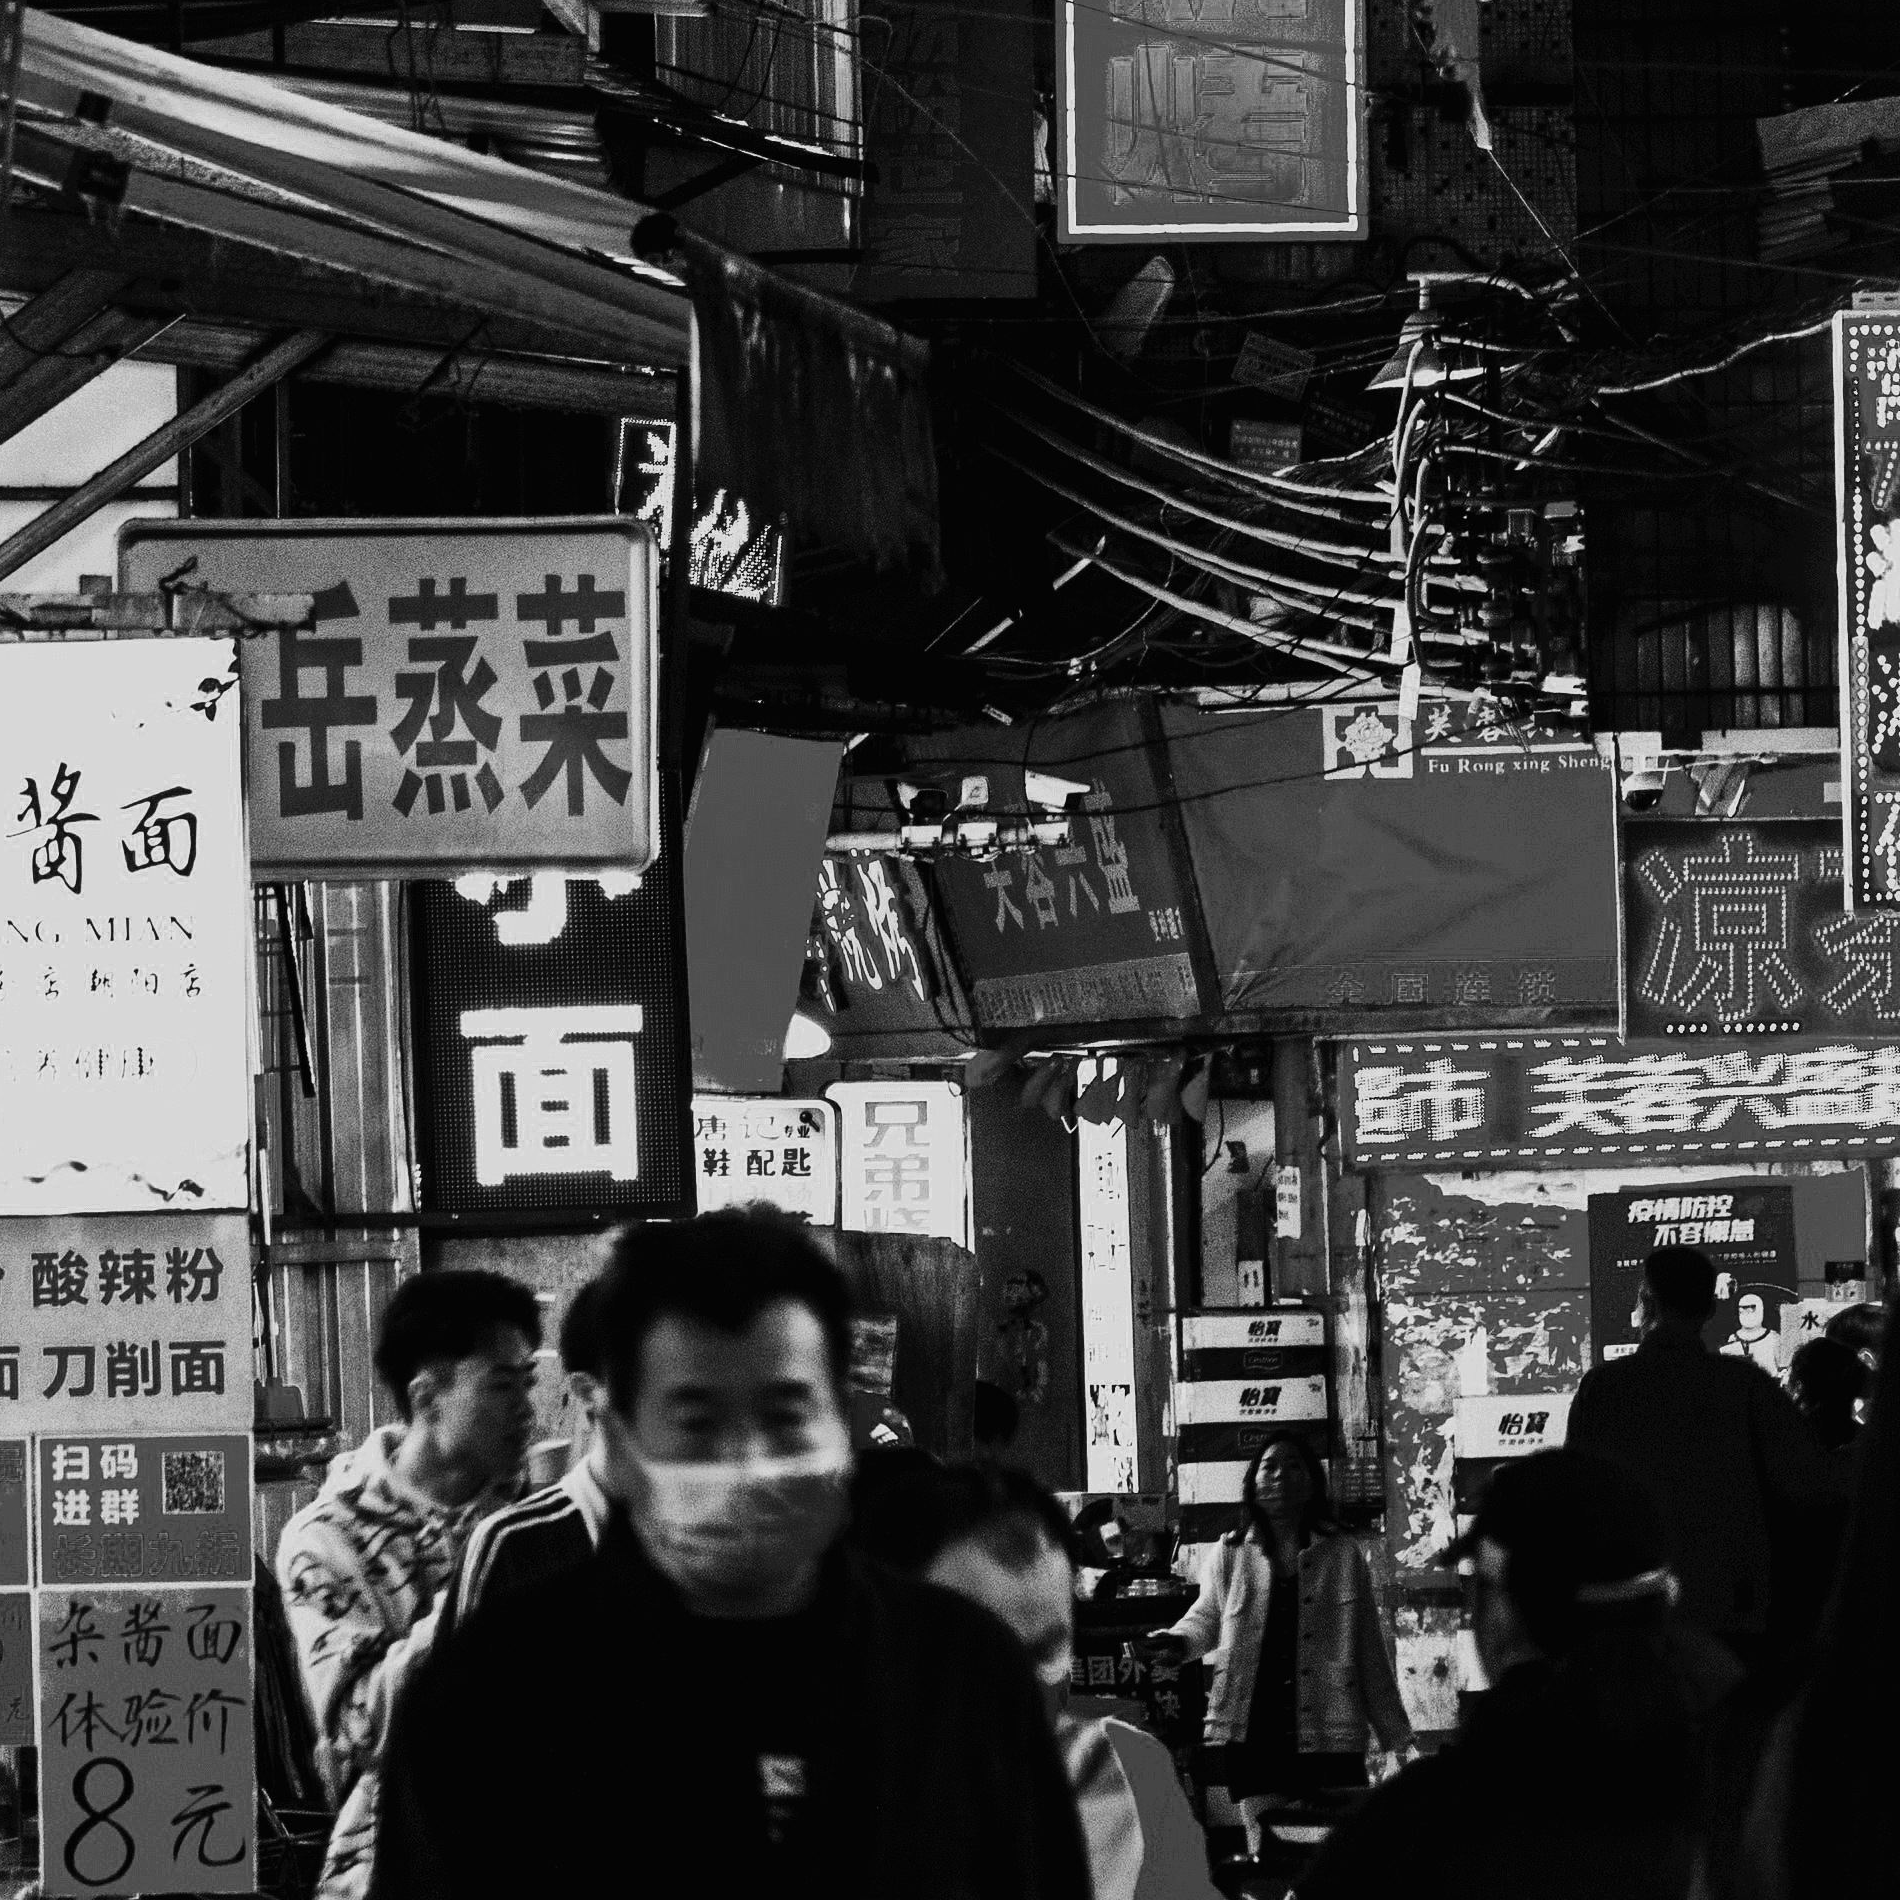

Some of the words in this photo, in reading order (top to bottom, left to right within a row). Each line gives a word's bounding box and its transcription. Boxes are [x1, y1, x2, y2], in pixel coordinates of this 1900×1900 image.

[1427, 758, 1450, 775] Fu
[1457, 755, 1506, 779] Rong
[1512, 755, 1551, 779] xing
[1556, 752, 1614, 776] Sheng
[693, 1113, 781, 1142] 唐记
[1627, 1194, 1734, 1223] 疫情防控
[1653, 1218, 1755, 1247] 不容懈怠
[30, 1247, 225, 1310] 酸辣粉
[41, 1339, 226, 1401] 刀削面
[51, 1443, 139, 1482] 扫码
[51, 1488, 140, 1526] 进群
[52, 1531, 241, 1579] 长期九折
[48, 1599, 243, 1669] 杂酱面
[46, 1691, 247, 1755] 体验价
[62, 1755, 247, 1887] 8元
